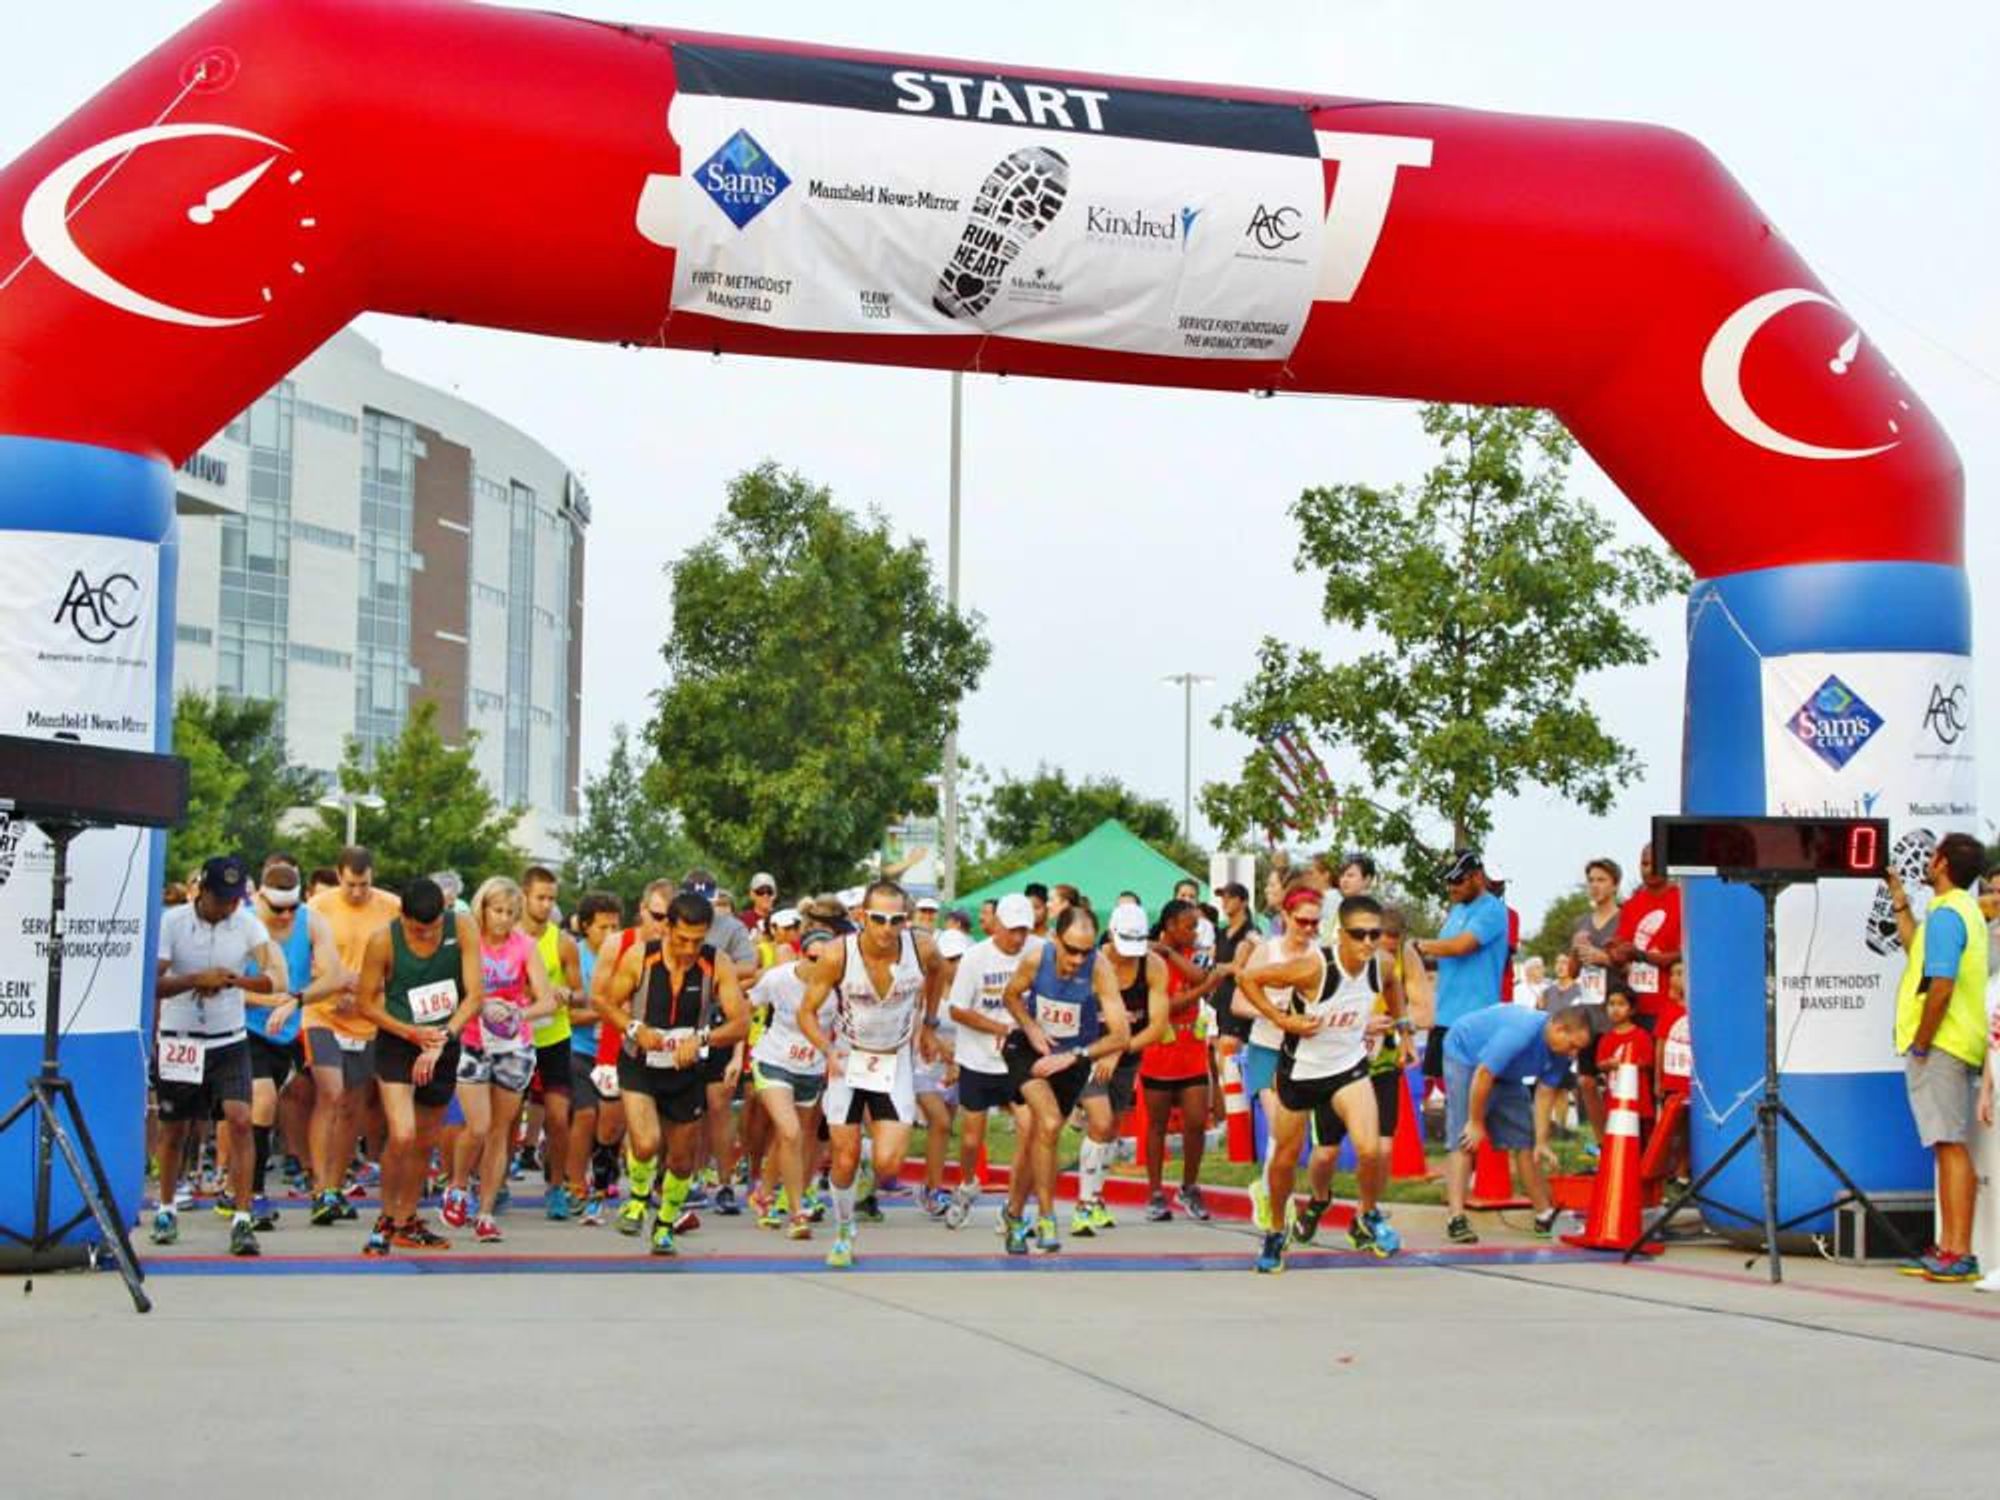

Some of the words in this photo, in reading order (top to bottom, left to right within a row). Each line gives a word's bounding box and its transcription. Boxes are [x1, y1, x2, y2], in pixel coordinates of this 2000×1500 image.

[892, 70, 1109, 131] START
[707, 163, 776, 196] Sam's
[808, 180, 874, 204] Mansfield
[878, 188, 960, 211] News-Mirror
[1086, 204, 1177, 240] Kindred
[962, 223, 1004, 254] RUN
[953, 244, 1009, 278] HEART
[691, 271, 723, 287] FIRST
[725, 273, 793, 294] METHODIST
[706, 291, 772, 312] MANSFIELD
[859, 291, 890, 304] KLEIN
[861, 305, 891, 318] TOOLS
[1178, 316, 1215, 331] SERVICE
[27, 711, 88, 729] Mansfield
[1799, 711, 1870, 739] Sam's
[1851, 827, 1876, 868] 0
[68, 918, 97, 935] FIRST
[1782, 975, 1811, 990] FIRST
[1815, 974, 1881, 990] METHODIST
[1800, 995, 1865, 1010] MANSFIELD
[166, 1042, 197, 1065] 220
